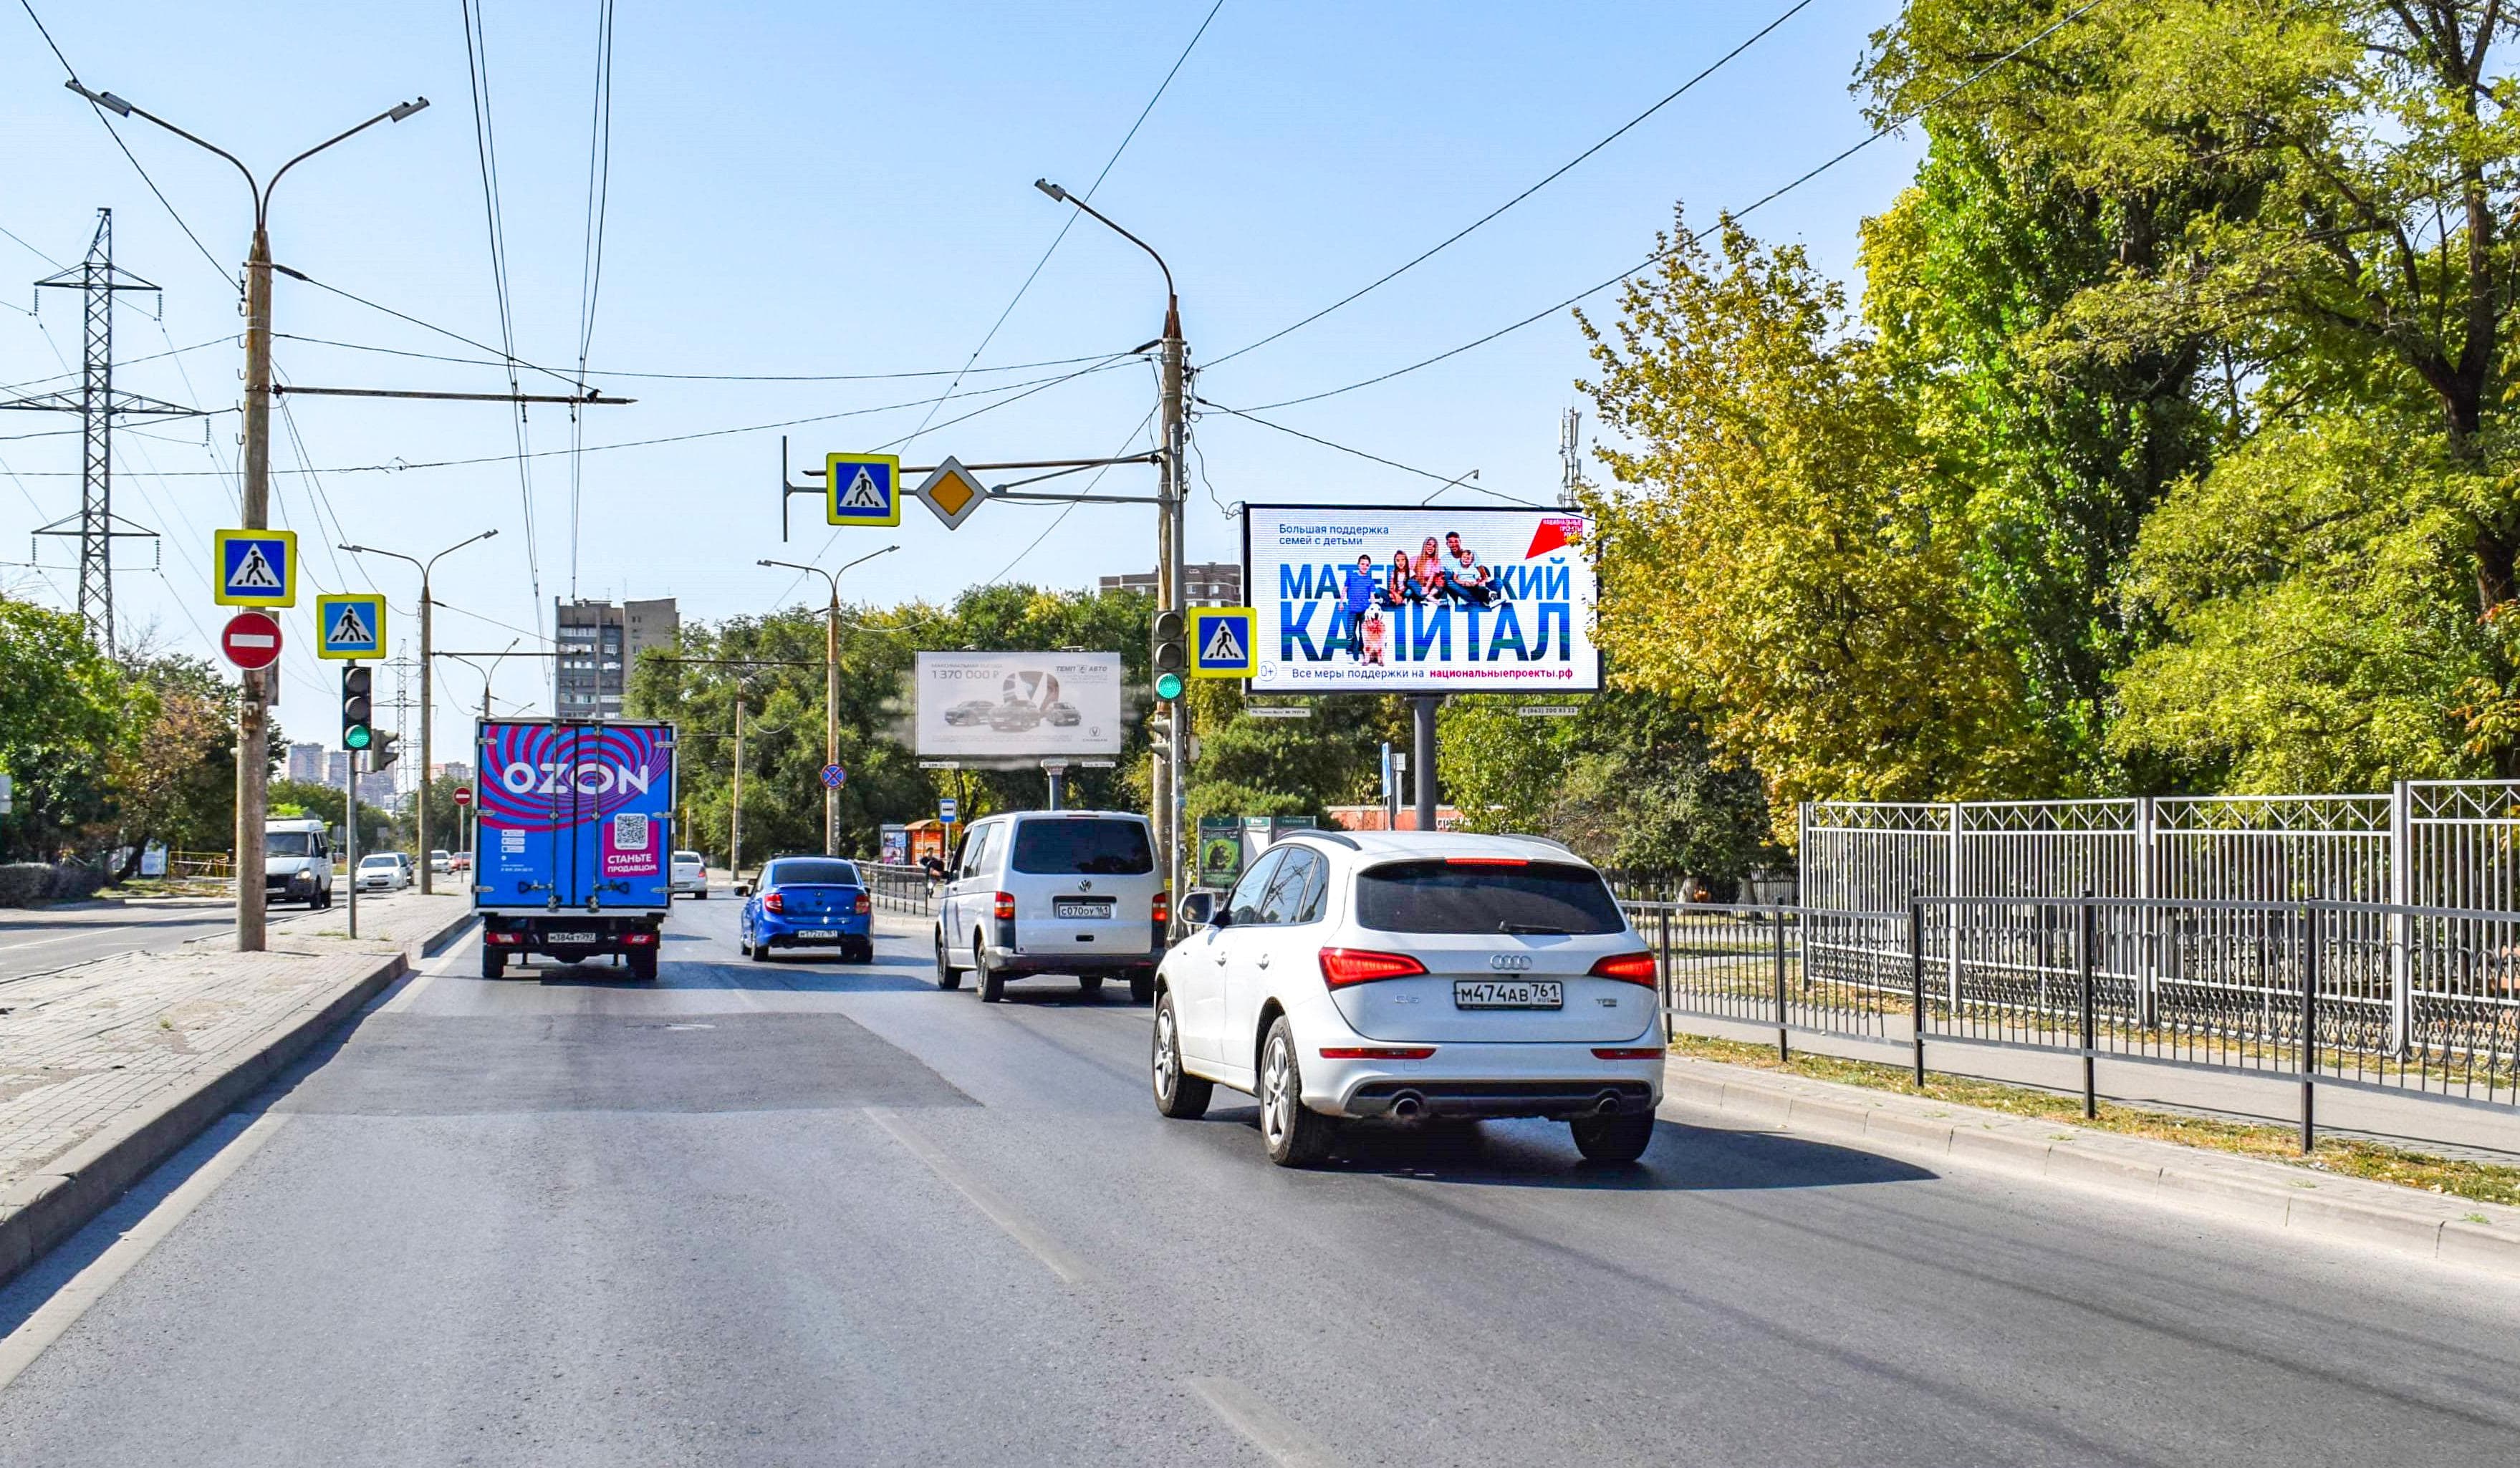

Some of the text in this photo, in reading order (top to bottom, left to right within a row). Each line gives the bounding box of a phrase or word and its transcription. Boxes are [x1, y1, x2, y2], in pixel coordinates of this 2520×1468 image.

[1279, 524, 1389, 536] Большая поддержка
[1279, 536, 1312, 544] семей
[1323, 537, 1362, 546] детьми
[1281, 601, 1571, 662] КАПИТАЛ
[966, 670, 990, 679] 000
[1292, 669, 1312, 678] Все
[1315, 670, 1344, 680] меры
[1347, 670, 1409, 680] поддержки
[1430, 667, 1573, 680] национальныепроекты.рф
[503, 762, 649, 794] OZON
[607, 854, 652, 864] СТАНЬТЕ
[607, 864, 657, 873] ПРОДАВЦОМ
